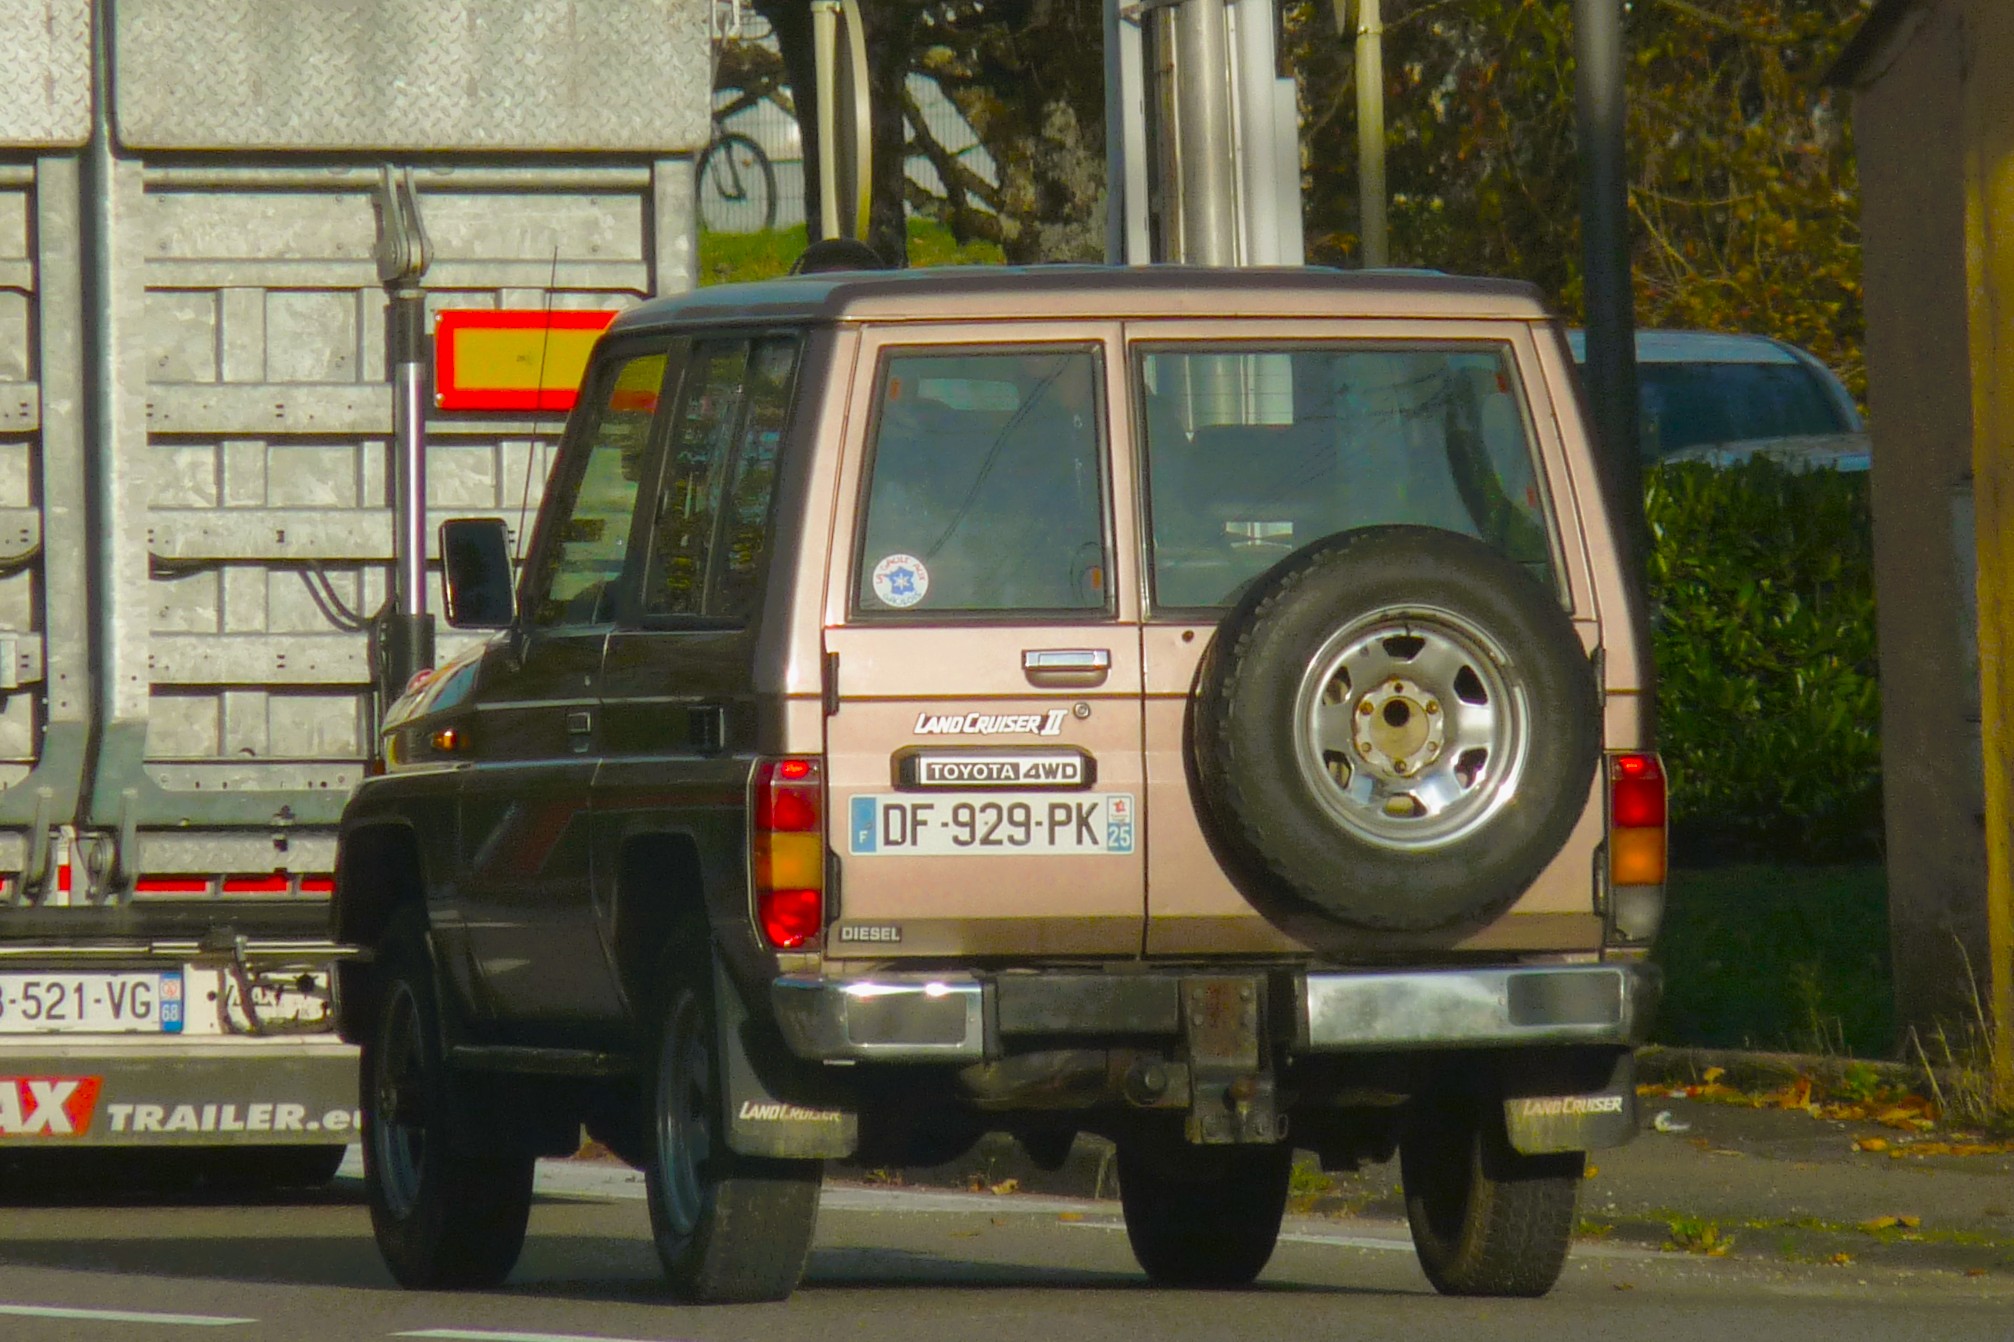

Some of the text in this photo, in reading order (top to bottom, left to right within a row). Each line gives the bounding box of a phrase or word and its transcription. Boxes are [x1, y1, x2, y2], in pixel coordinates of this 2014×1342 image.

[931, 762, 1078, 780] TOYOTA 4WD
[883, 802, 1099, 846] DF-929-PK
[859, 830, 868, 844] F
[1108, 825, 1131, 847] 25
[841, 926, 901, 941] DIESEL
[0, 981, 151, 1020] -521-VG
[162, 1003, 179, 1021] 68
